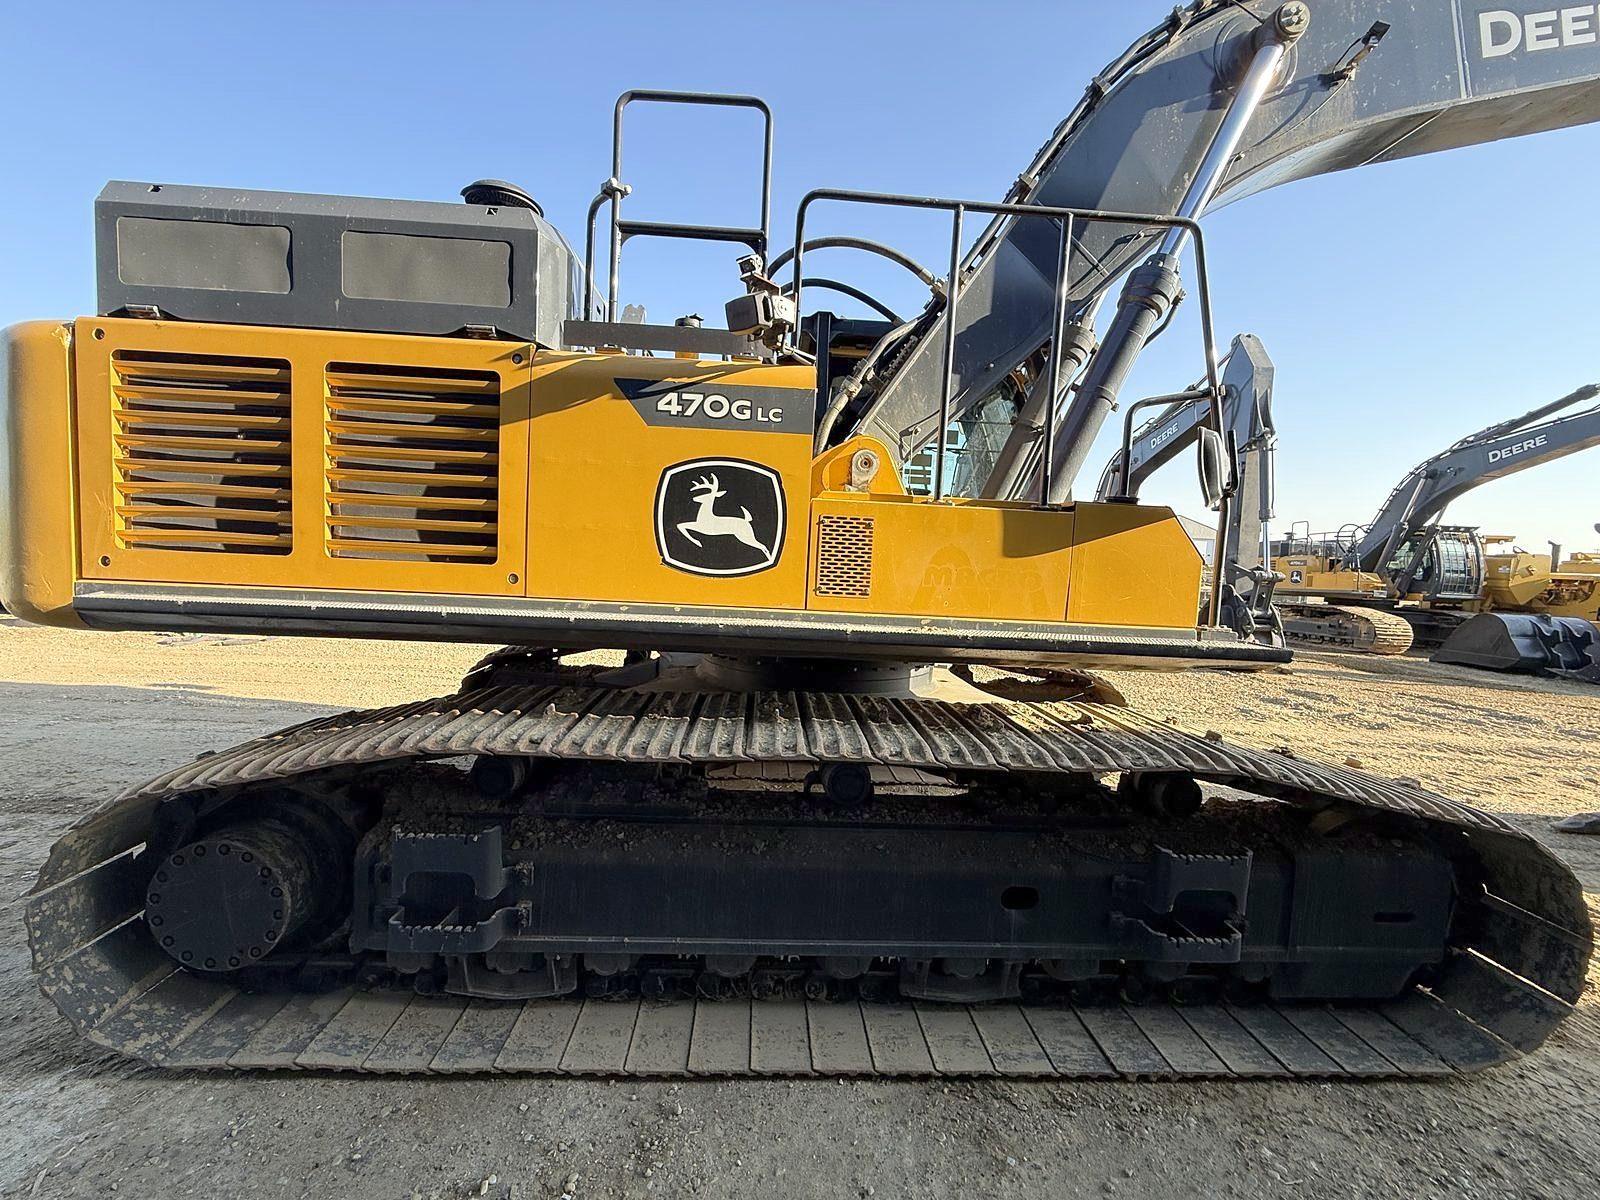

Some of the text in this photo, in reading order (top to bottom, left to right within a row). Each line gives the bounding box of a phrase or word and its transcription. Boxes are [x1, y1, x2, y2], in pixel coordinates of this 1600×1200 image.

[1479, 4, 1600, 58] DEE
[657, 391, 783, 423] 470G LC
[1150, 422, 1179, 449] DEERE
[1487, 434, 1548, 463] DEERE
